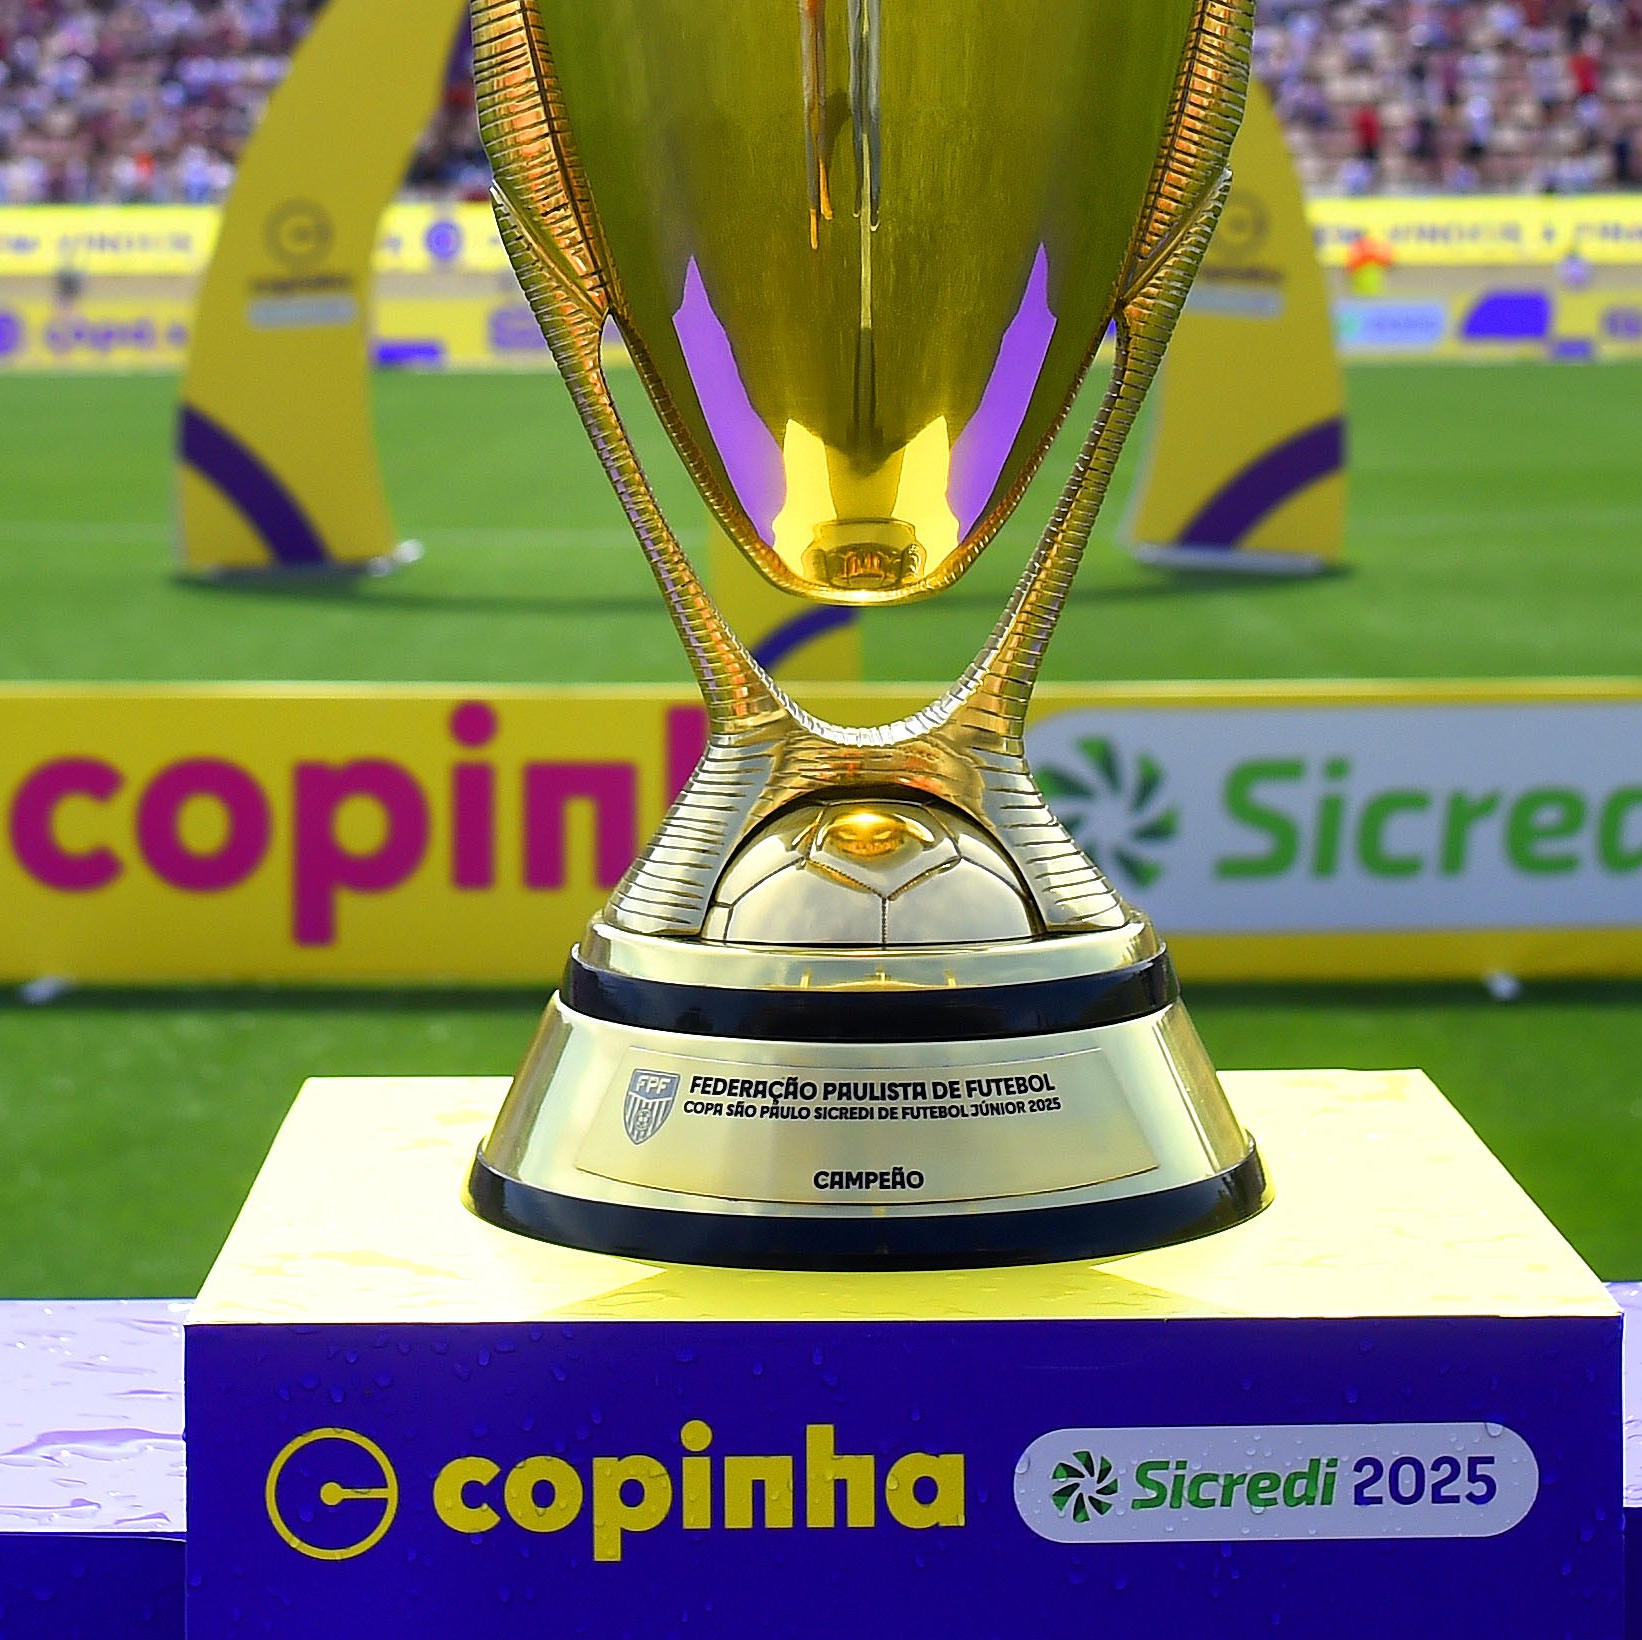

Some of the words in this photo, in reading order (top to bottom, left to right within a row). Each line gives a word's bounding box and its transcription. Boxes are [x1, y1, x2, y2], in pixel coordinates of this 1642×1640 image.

[7, 698, 709, 947] copin
[636, 1074, 671, 1095] FPF
[689, 1075, 818, 1105] FEDERAÇÃO
[822, 1082, 927, 1101] PAULISTA
[932, 1081, 962, 1100] DE
[965, 1073, 1056, 1098] FUTEBOL
[683, 1100, 723, 1116] COPA
[726, 1101, 757, 1118] SÃO
[759, 1105, 811, 1120] PAULO
[813, 1107, 874, 1120] SICREDI
[878, 1107, 899, 1120] DE
[901, 1105, 968, 1120] FUTEBOL
[970, 1100, 1026, 1117] JÚNIOR
[1028, 1097, 1061, 1112] 2025
[813, 1166, 924, 1190] CAMPEÃO
[432, 1419, 965, 1562] copinha
[1131, 1458, 1337, 1512] Sicredi
[1353, 1455, 1497, 1507] 2025
